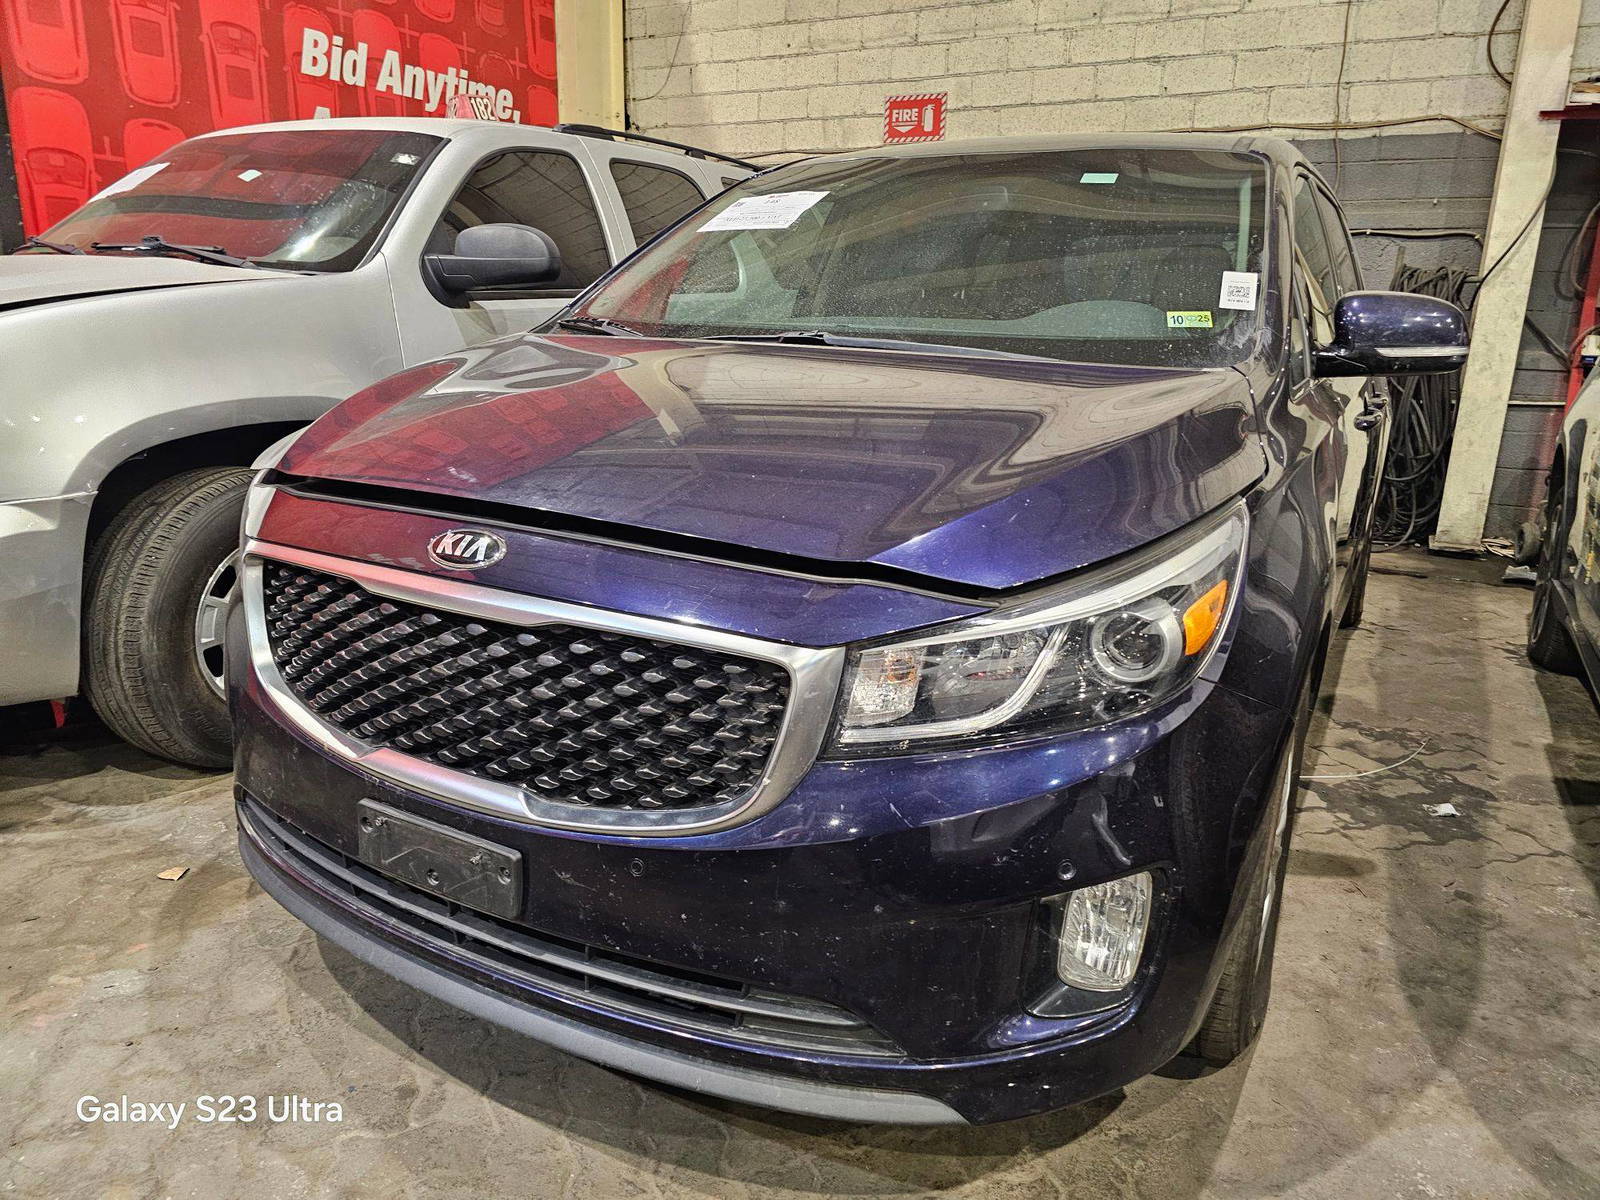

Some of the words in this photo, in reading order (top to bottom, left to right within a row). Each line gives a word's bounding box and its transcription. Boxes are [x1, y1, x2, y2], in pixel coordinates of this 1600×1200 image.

[301, 27, 368, 88] Bid
[470, 97, 497, 121] 182
[892, 108, 919, 122] FIRE
[1170, 315, 1184, 325] 10
[1198, 314, 1210, 323] 25
[435, 533, 490, 562] KIA
